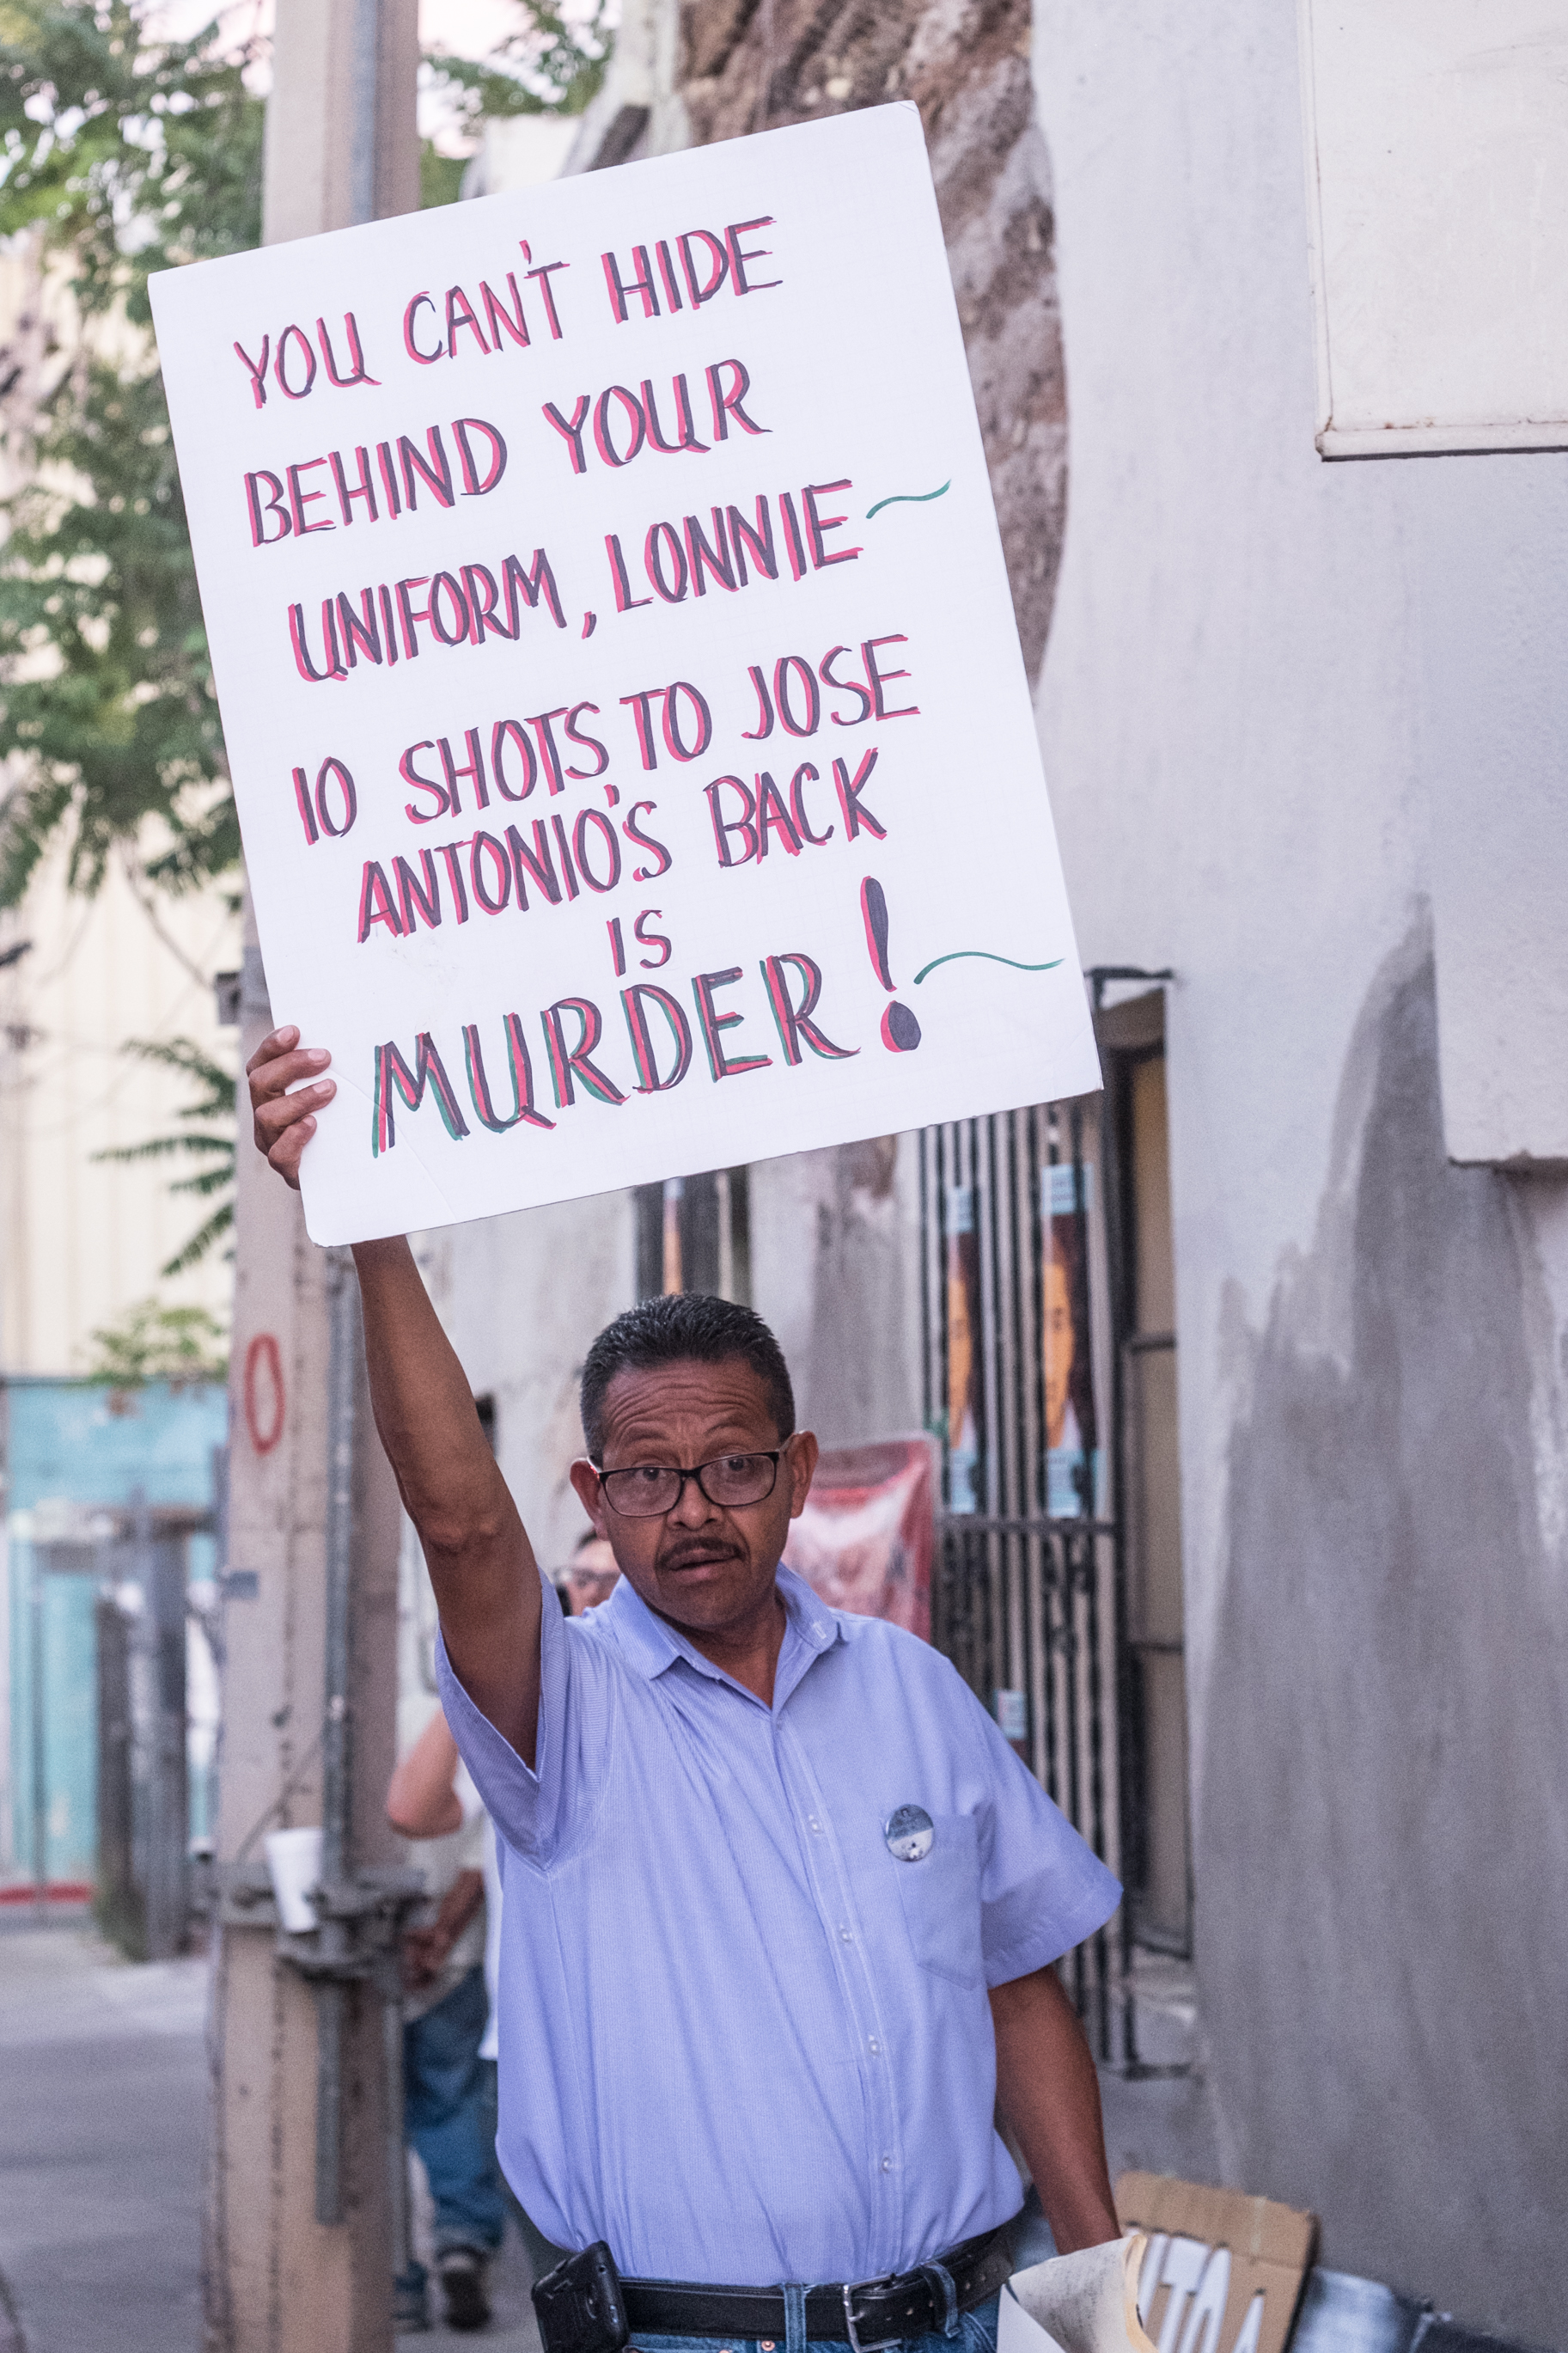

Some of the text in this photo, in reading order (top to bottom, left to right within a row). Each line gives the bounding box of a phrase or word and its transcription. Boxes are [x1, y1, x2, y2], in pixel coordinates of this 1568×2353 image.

[234, 216, 783, 409] YOU CAN'T HIDE
[243, 359, 773, 547] BEHIND YOUR
[288, 479, 864, 683] UNIFORM, LONNIE
[292, 634, 920, 846] 10 SHOTS TO JOSE
[357, 748, 888, 944] ANTONIO'S BACK
[607, 909, 673, 977] IS
